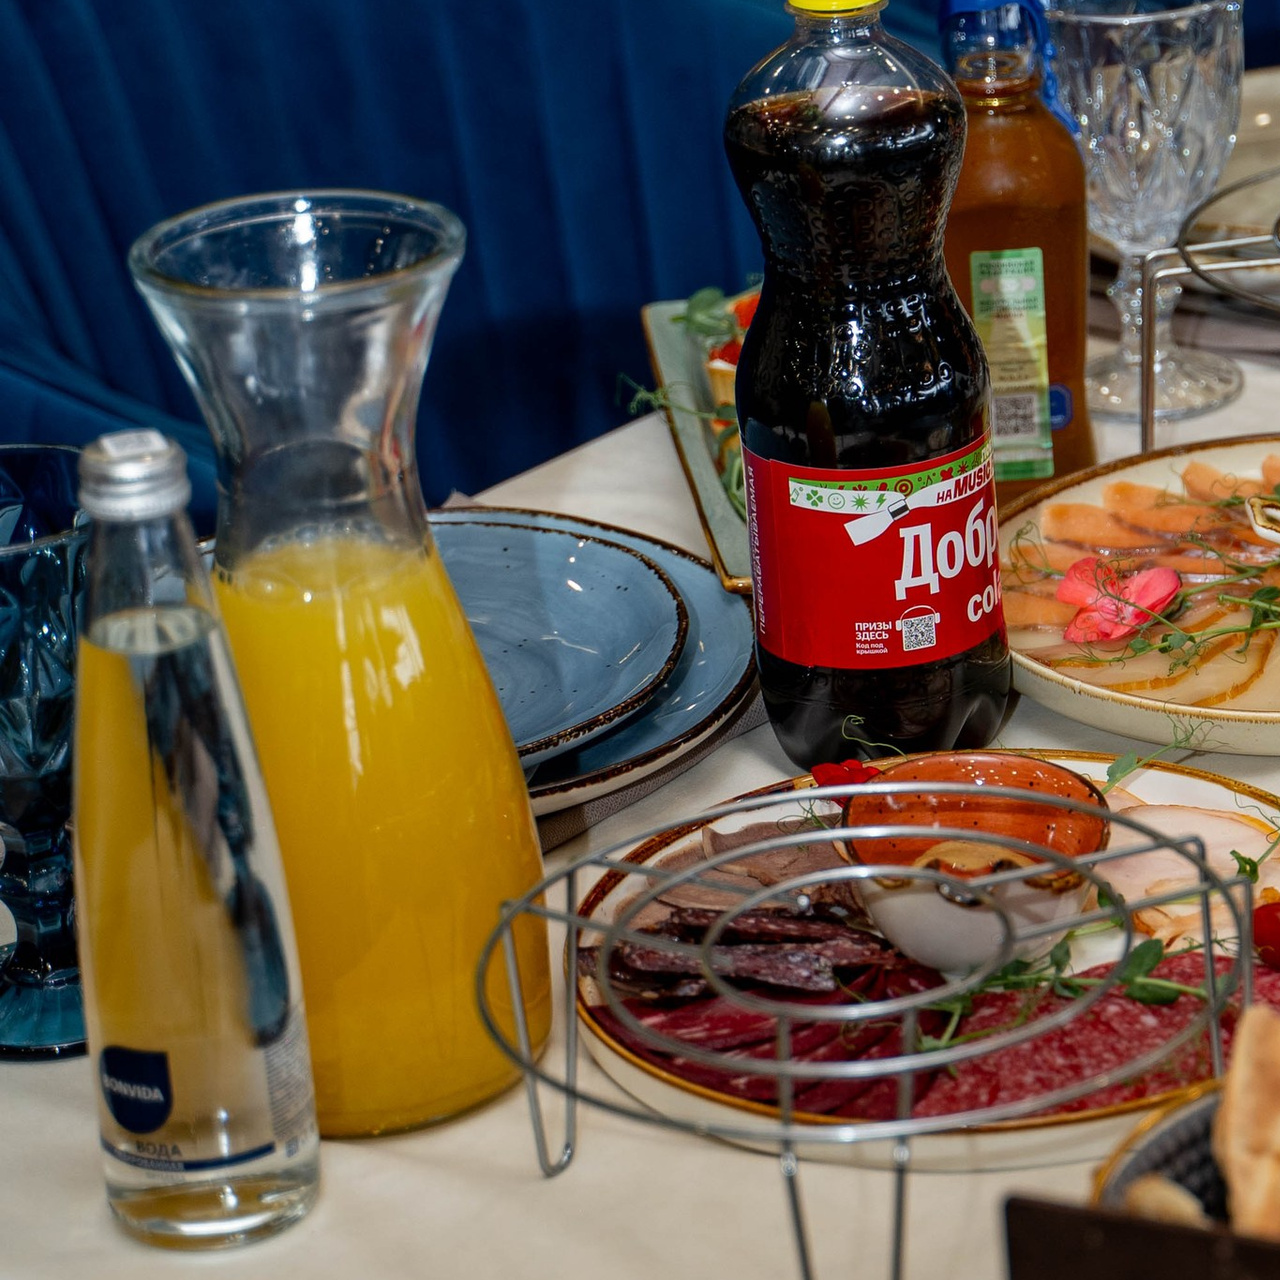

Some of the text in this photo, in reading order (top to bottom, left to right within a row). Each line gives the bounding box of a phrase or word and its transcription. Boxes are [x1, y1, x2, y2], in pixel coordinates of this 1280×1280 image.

[953, 462, 991, 499] MUSIC
[747, 464, 767, 635] ПЕРЕРАБАТЫВАЕМАЯ
[894, 497, 998, 601] Добр
[854, 621, 892, 631] ПРИЗЫ
[855, 631, 889, 641] ЗДЕСЬ
[855, 642, 884, 650] Код под
[856, 648, 888, 656] крышкой
[102, 1073, 164, 1102] BONVIDA
[135, 1140, 183, 1159] ВОДА
